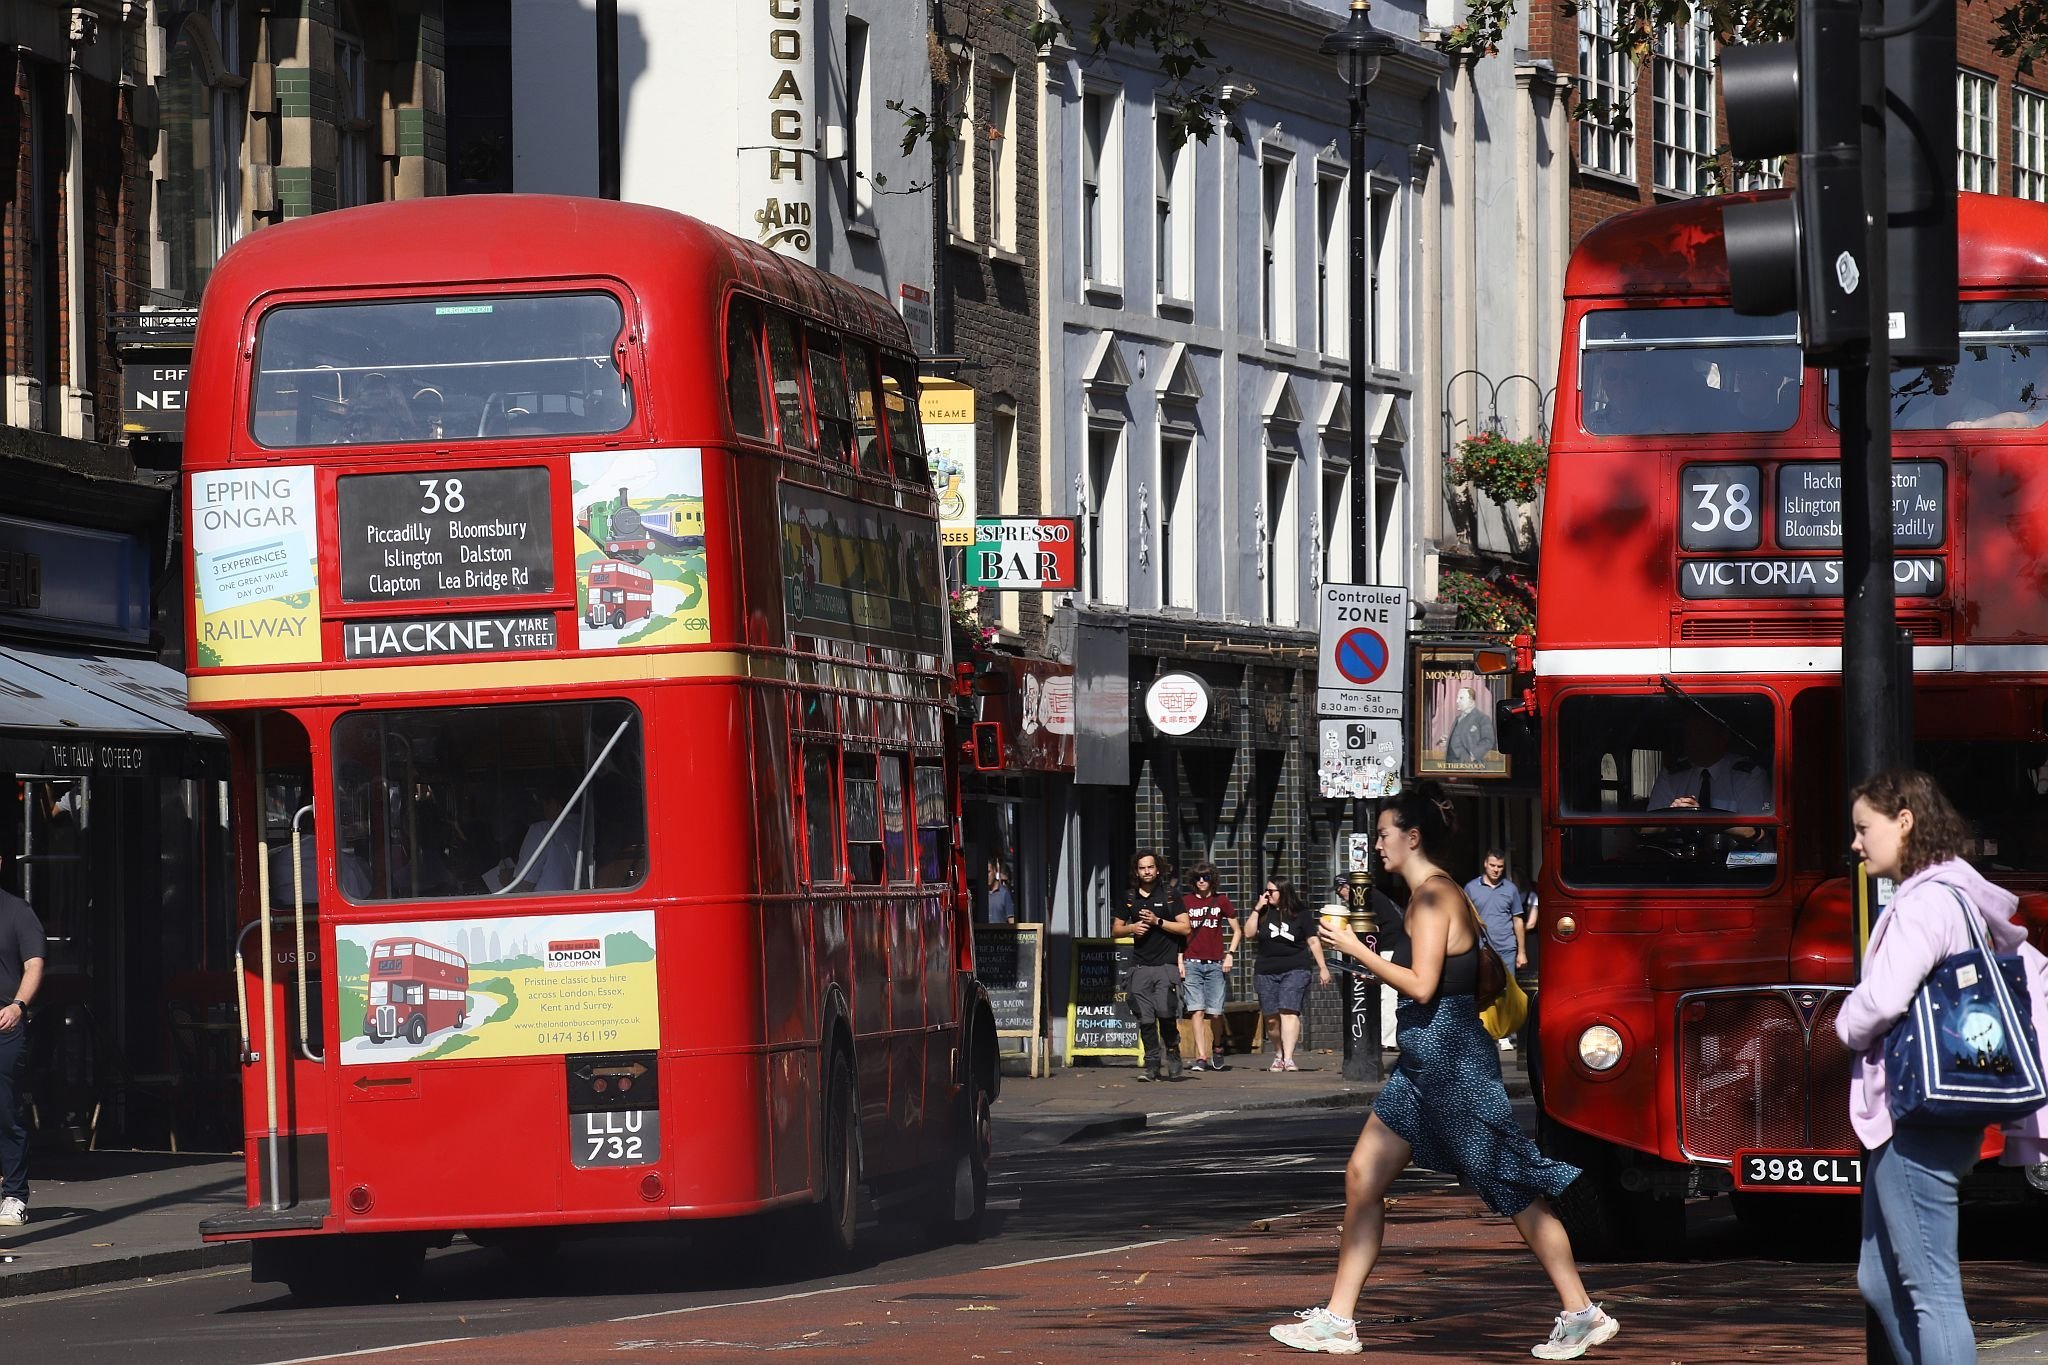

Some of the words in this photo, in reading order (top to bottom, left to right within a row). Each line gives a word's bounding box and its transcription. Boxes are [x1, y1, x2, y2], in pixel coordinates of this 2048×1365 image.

[136, 390, 188, 409] NE
[929, 409, 967, 418] NEAME
[207, 479, 291, 503] EPPING
[419, 478, 465, 514] 38
[1691, 483, 1753, 532] 38
[1784, 496, 1841, 517] Islington
[1915, 494, 1937, 512] Ave
[204, 506, 297, 531] ONGAR
[367, 522, 432, 544] Piccadilly
[449, 518, 527, 540] Bloomsbury
[213, 565, 219, 575] 3
[222, 549, 287, 573] EXPERIENCES
[384, 549, 443, 570] Islington
[460, 545, 512, 563] Dalston
[978, 550, 1061, 582] BAR
[218, 580, 236, 592] ONE
[237, 575, 262, 588] GREAT
[265, 569, 289, 582] VALUE
[369, 574, 421, 596] Clapton
[438, 571, 460, 589] Lea
[465, 568, 508, 591] Bridge
[512, 567, 528, 586] Rd
[1689, 561, 1817, 585] VICTORIA
[237, 588, 252, 599] DAY
[1327, 589, 1402, 605] Controlled
[1337, 606, 1389, 623] ZONE
[204, 616, 308, 641] RAILWAY
[518, 618, 549, 631] MARE
[354, 619, 516, 655] HACKNEY
[514, 632, 555, 647] STREET
[1340, 693, 1359, 702] Mon
[1366, 694, 1382, 703] Sat
[1320, 702, 1342, 711] 8.30
[1363, 704, 1385, 714] 6.30
[1386, 707, 1399, 715] pm
[52, 745, 68, 767] THE
[1342, 756, 1382, 767] Traffic
[1210, 906, 1221, 918] UP
[277, 951, 317, 964] USD
[549, 950, 600, 962] LONDON
[564, 959, 600, 968] COMPANY
[524, 977, 558, 986] Pristine
[560, 976, 588, 985] classic
[591, 974, 606, 983] bus
[609, 973, 626, 982] hire
[528, 992, 556, 1000] across
[559, 988, 596, 998] London,
[598, 987, 625, 996] Essex,
[540, 1003, 562, 1012] Kent
[564, 1002, 580, 1011] and
[583, 1001, 614, 1011] Surrey.
[1076, 1005, 1115, 1016] FALAFEL
[538, 1031, 572, 1044] 01474
[576, 1030, 617, 1042] 361199
[1075, 1032, 1100, 1043] LATTE
[1105, 1032, 1138, 1042] ESPRESSO
[587, 1110, 642, 1135] LLU
[587, 1136, 643, 1161] 732
[1750, 1158, 1804, 1182] 398
